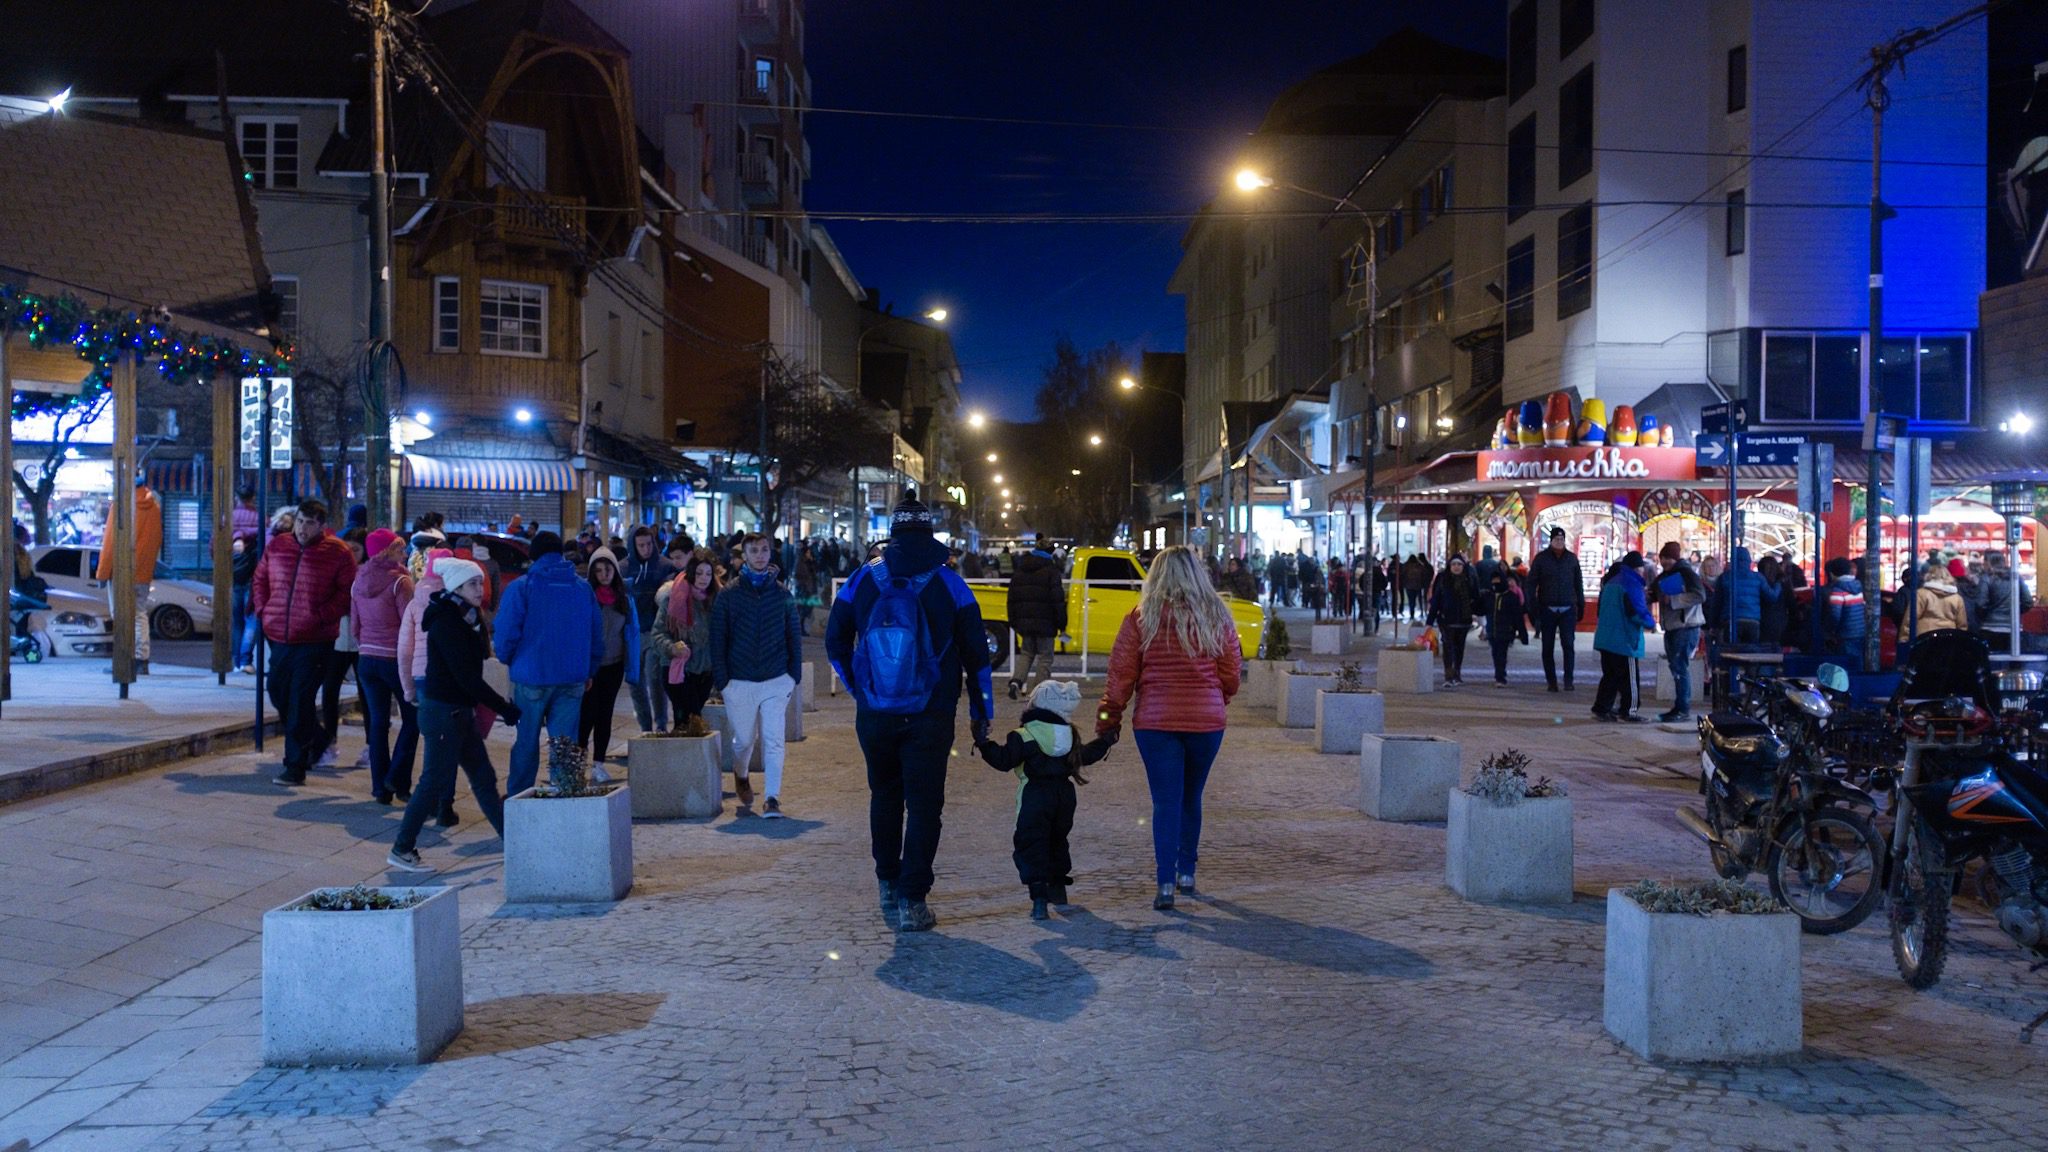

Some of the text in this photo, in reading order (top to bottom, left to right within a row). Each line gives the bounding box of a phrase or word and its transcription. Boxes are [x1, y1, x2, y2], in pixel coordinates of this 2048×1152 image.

[1746, 437, 1771, 446] Sargento
[1778, 436, 1805, 444] ROLANDO
[1486, 447, 1650, 478] mamuschka
[1747, 455, 1761, 463] 200
